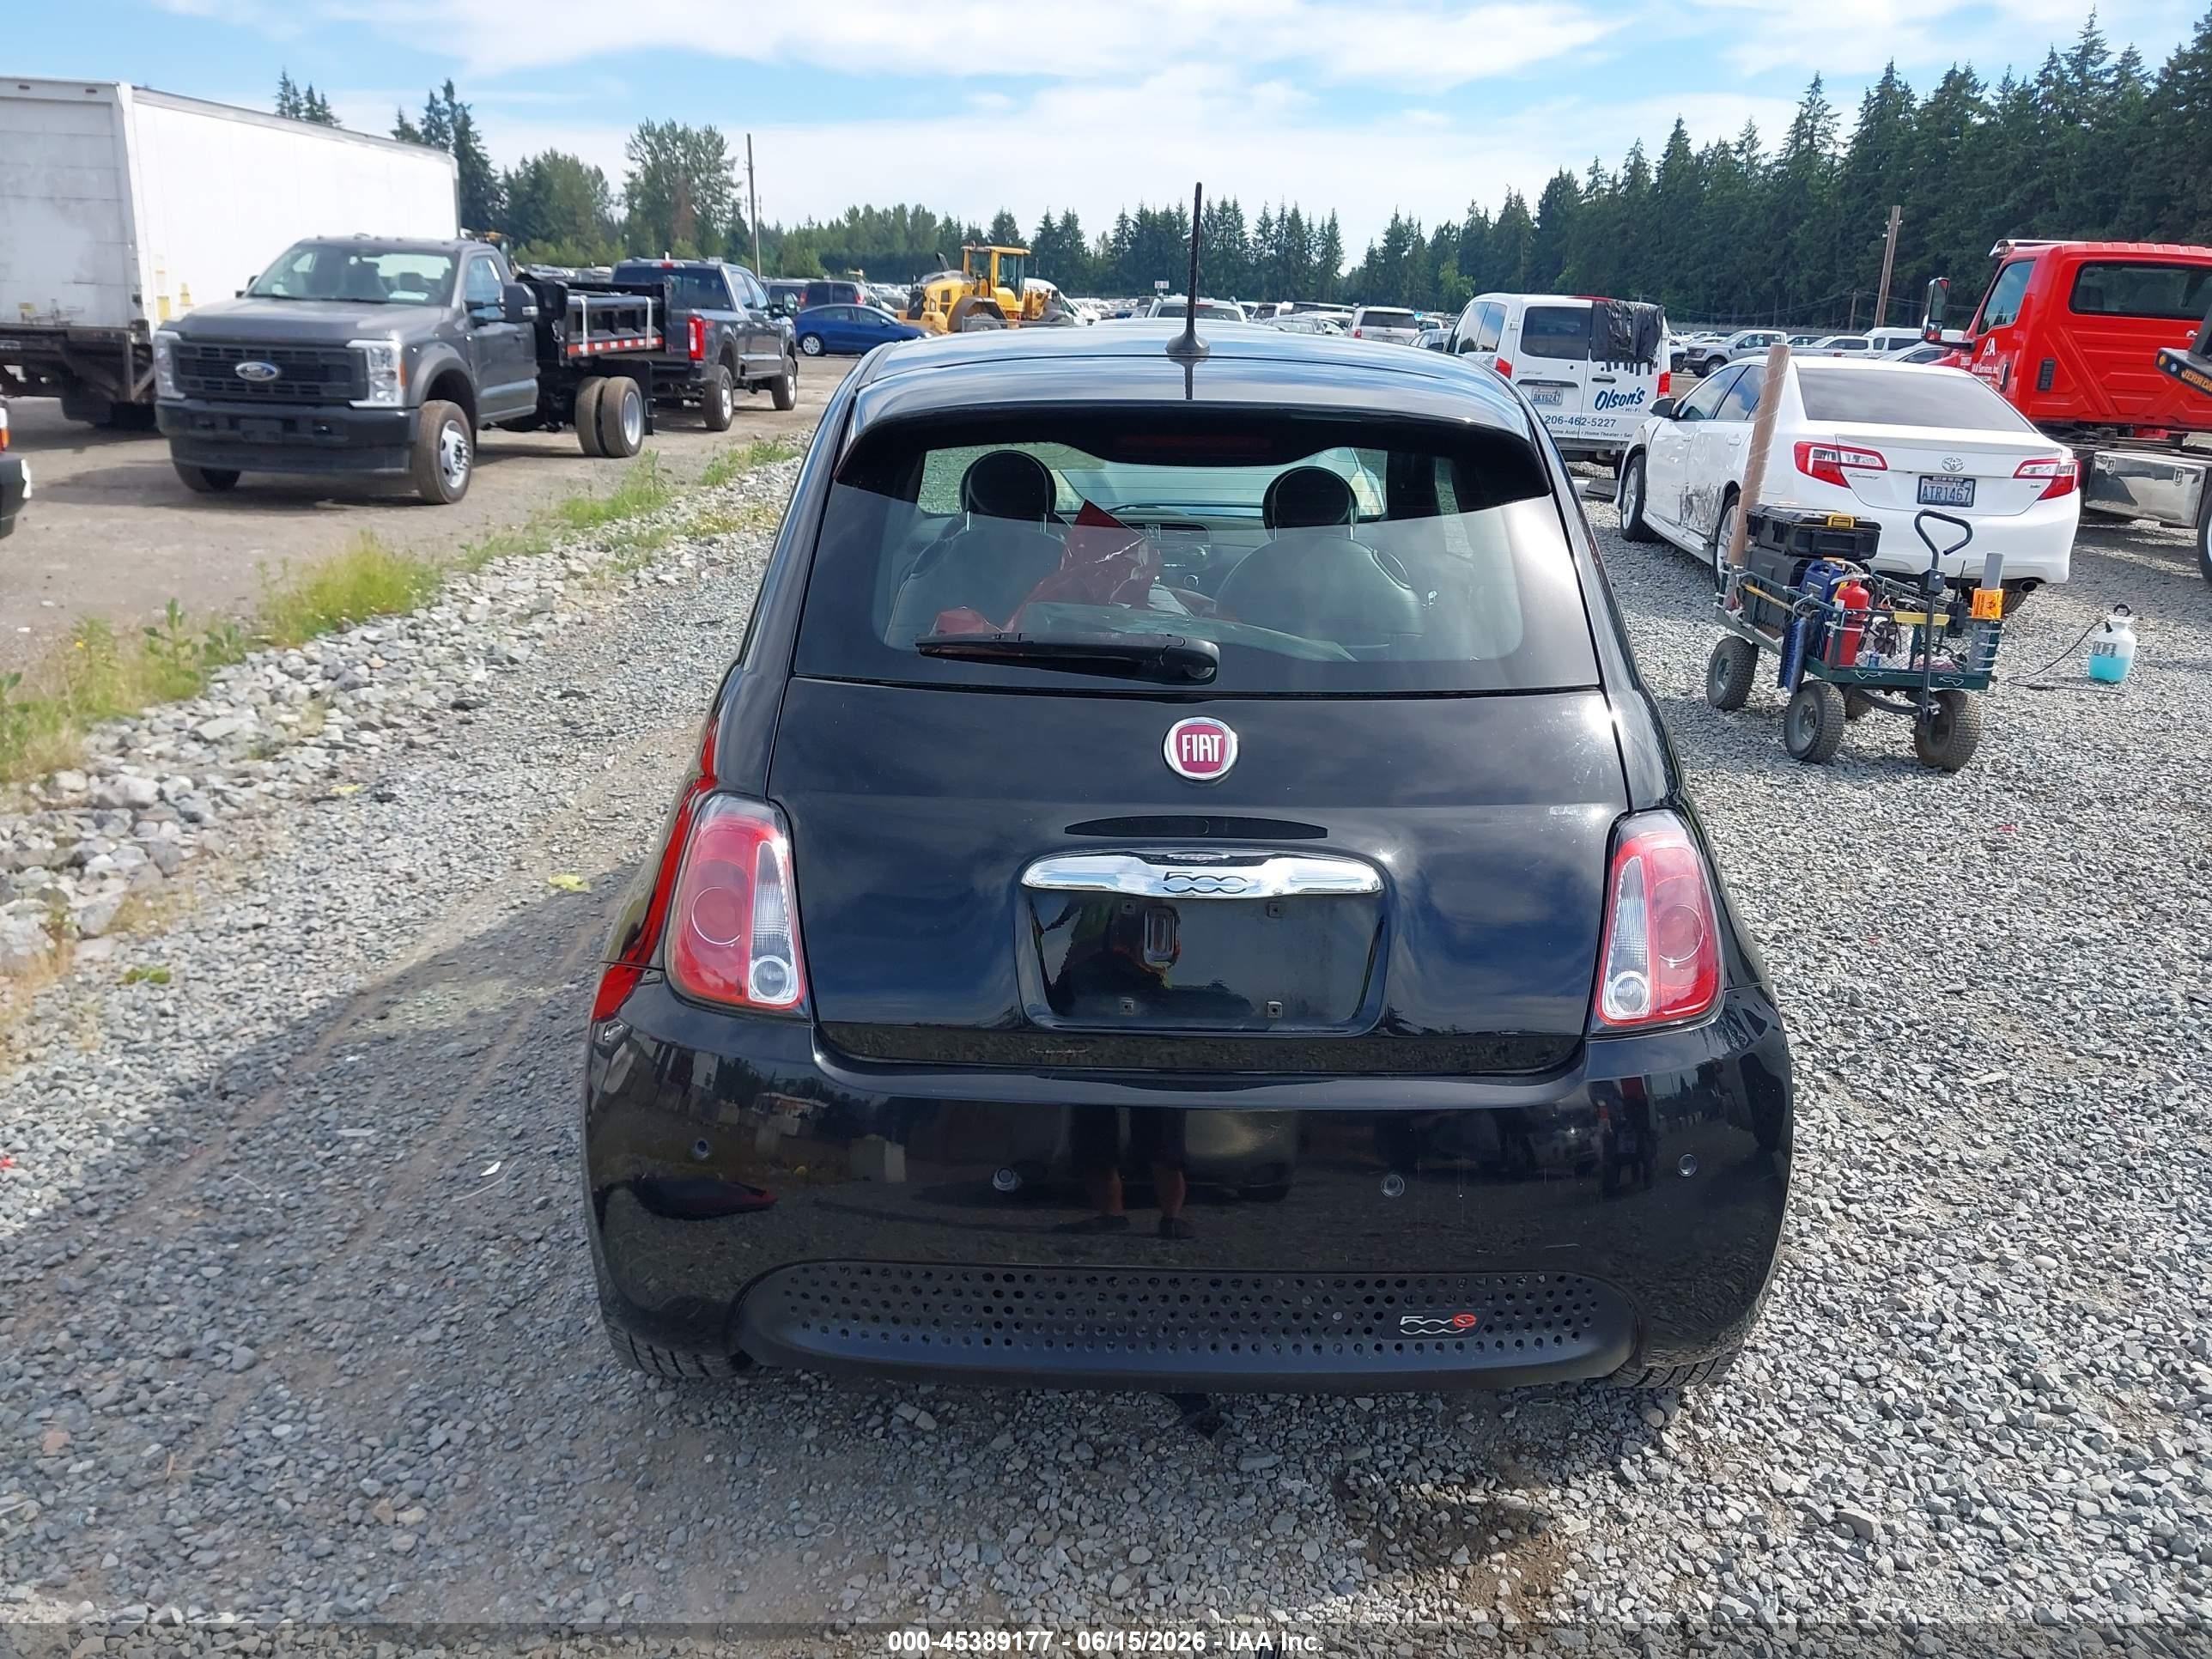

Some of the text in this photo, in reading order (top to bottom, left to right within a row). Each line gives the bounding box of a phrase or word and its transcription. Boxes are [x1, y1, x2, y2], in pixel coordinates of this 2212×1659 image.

[1595, 386, 1645, 411] Olson's
[1546, 415, 1617, 428] 206-462-5227
[1922, 485, 1971, 502] ATR1467
[1182, 733, 1223, 763] FIAT
[1163, 871, 1249, 894] 500
